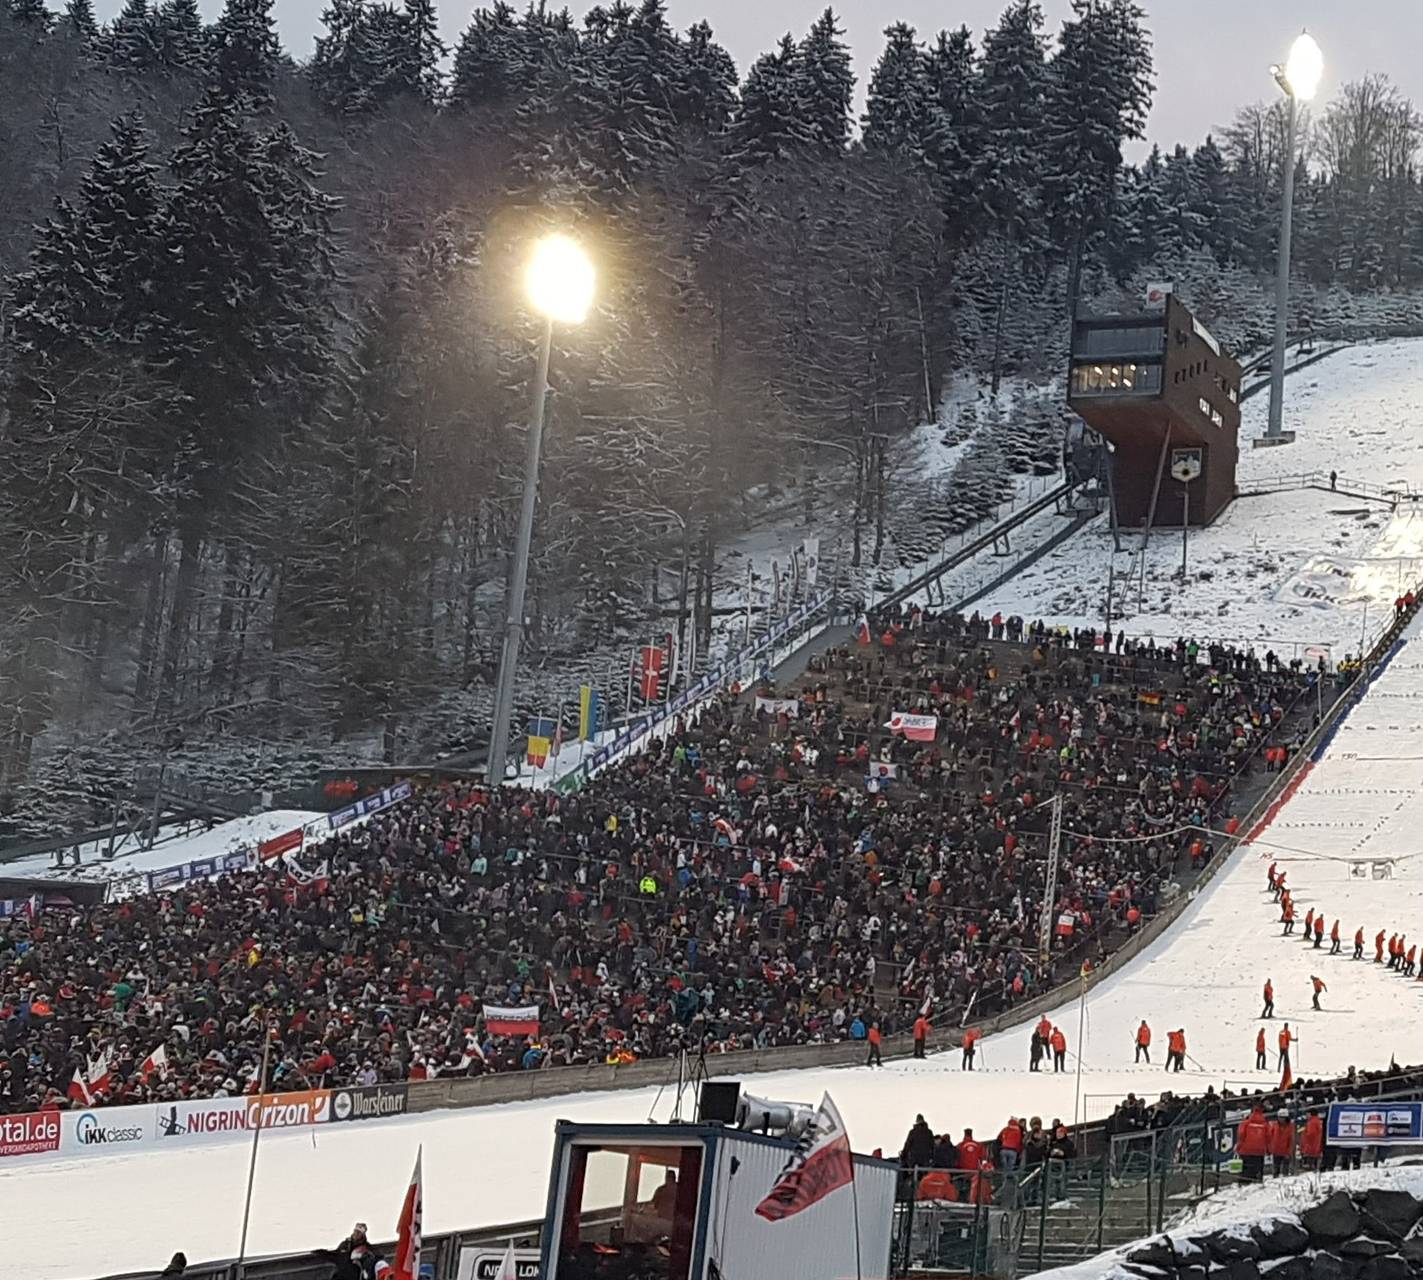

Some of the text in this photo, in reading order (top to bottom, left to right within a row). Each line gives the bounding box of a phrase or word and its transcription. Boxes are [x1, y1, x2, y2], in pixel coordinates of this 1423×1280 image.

[187, 1109, 245, 1133] NIGRIN
[249, 1098, 309, 1128] Orizon
[0, 1116, 57, 1143] tal.de
